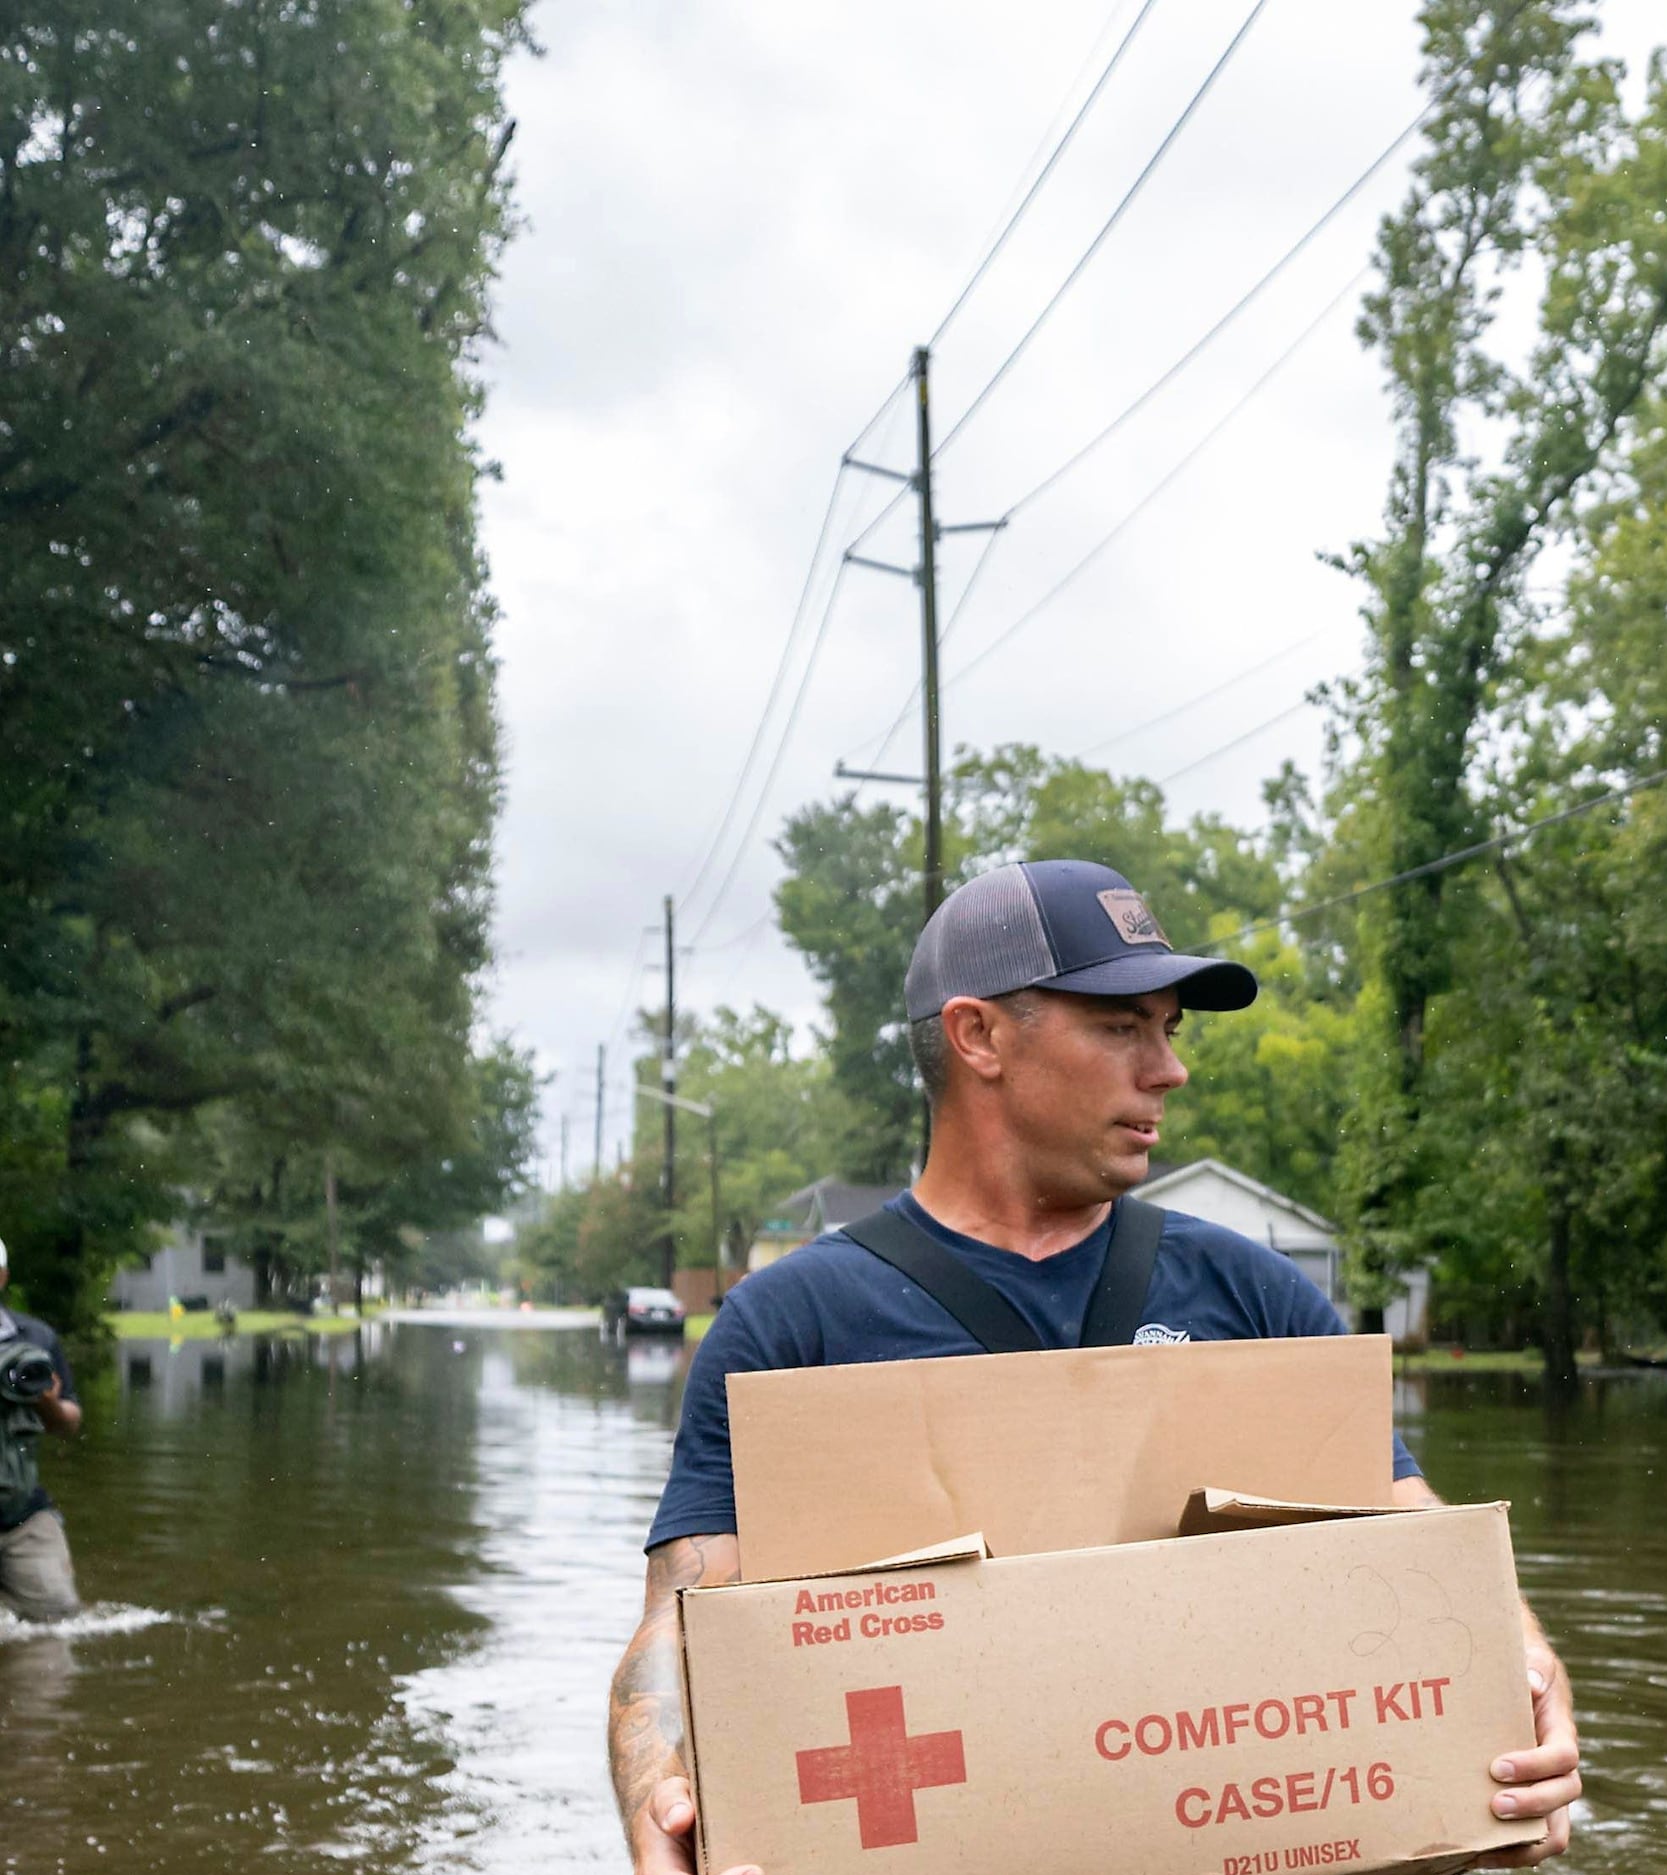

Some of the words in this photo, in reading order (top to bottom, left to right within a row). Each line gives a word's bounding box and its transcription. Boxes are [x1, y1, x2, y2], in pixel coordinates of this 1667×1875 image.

[794, 1582, 936, 1614] American
[792, 1618, 852, 1647] Red
[860, 1611, 945, 1638] Cross
[1095, 1689, 1357, 1761] COMFORT
[1373, 1677, 1450, 1724] KIT
[1175, 1762, 1395, 1828] CASE/16
[1285, 1839, 1361, 1870] UNISEX
